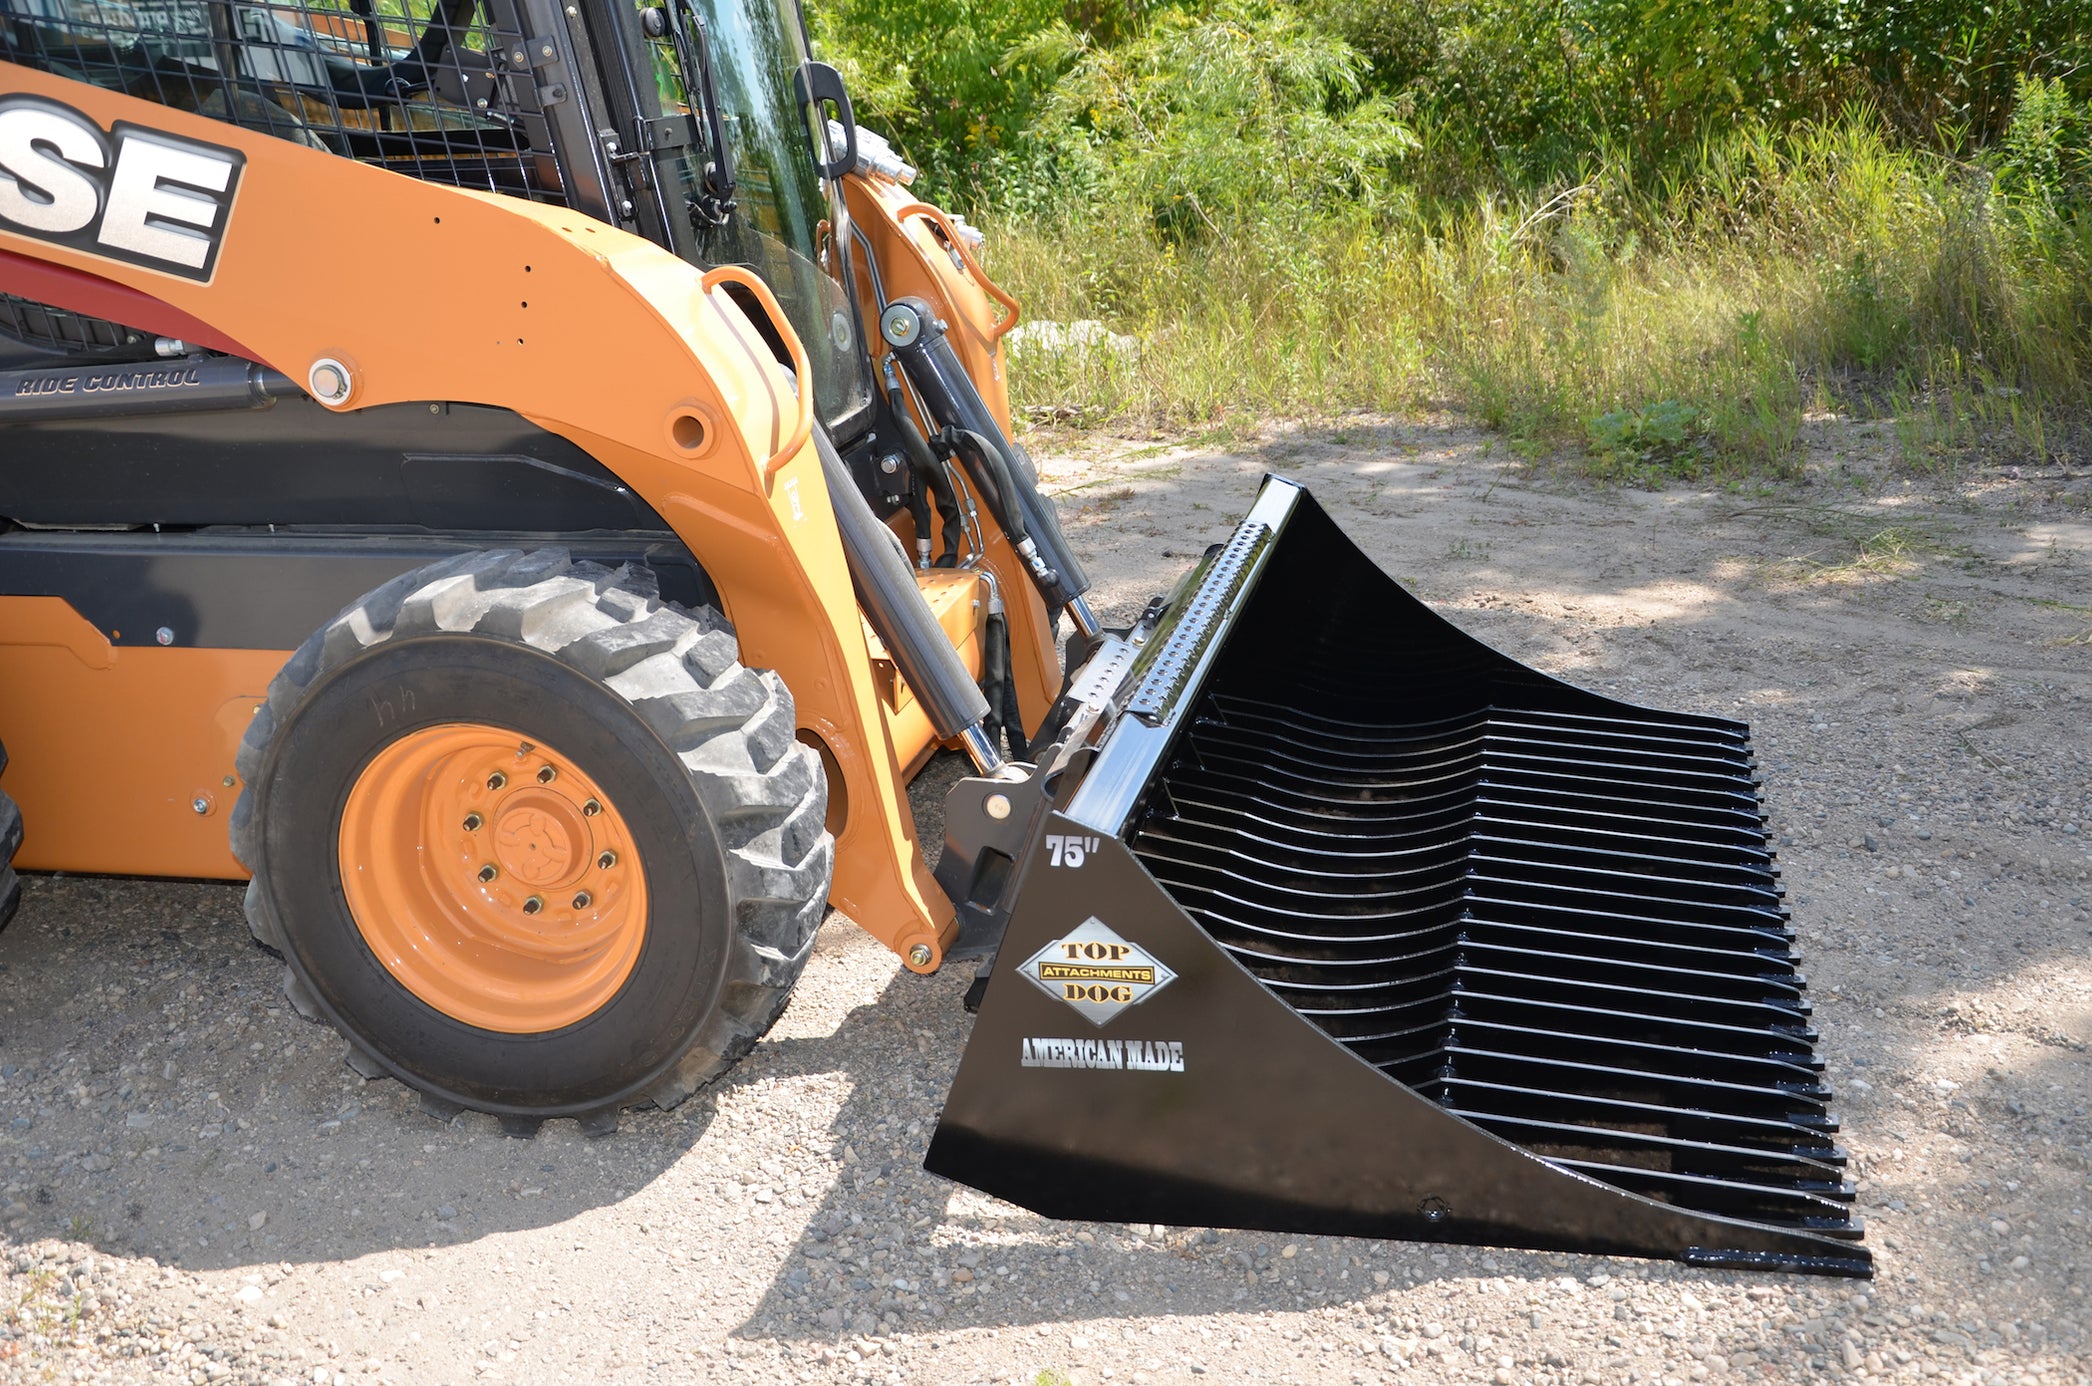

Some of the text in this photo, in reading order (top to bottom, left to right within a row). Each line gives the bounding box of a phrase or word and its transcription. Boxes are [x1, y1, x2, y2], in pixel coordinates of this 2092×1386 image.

[15, 369, 200, 396] RIDE CONTROL
[1046, 835, 1100, 867] 75"
[1061, 942, 1130, 961] TOP
[1043, 966, 1151, 981] ATTACHMENTS
[1063, 983, 1133, 1003] DOG
[1021, 1038, 1185, 1072] AMERICAN MADE
